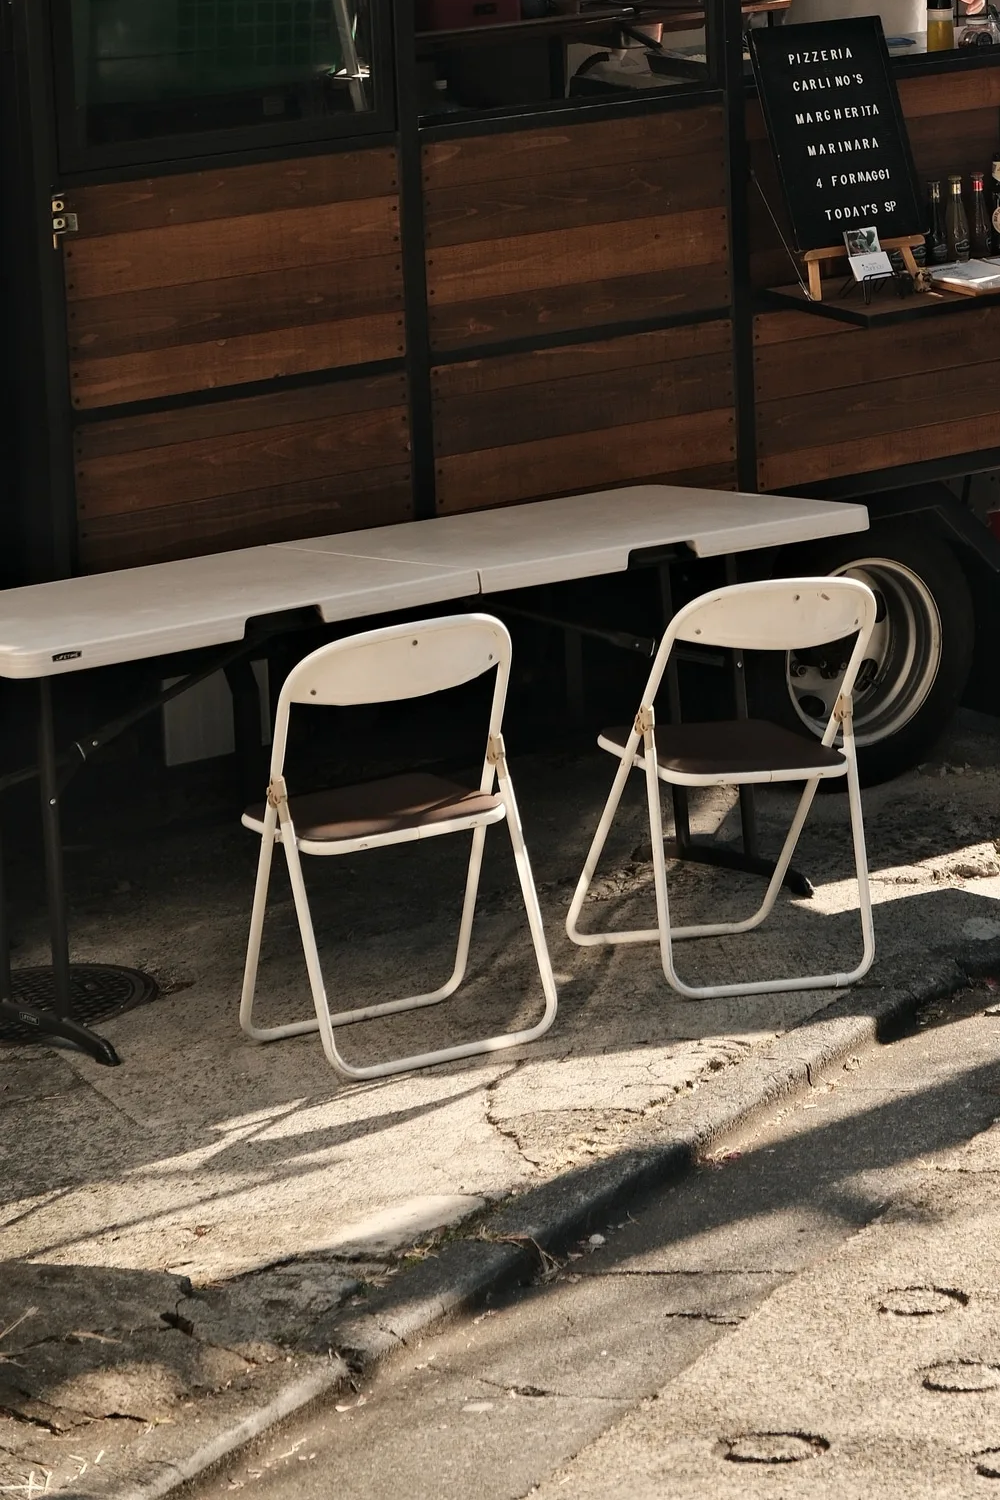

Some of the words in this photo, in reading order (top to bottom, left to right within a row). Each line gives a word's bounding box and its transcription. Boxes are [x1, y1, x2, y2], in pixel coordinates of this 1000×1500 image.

[788, 47, 853, 65] PIZZERIA
[795, 103, 880, 125] MARGHERITA
[807, 137, 880, 156] MARINARA
[816, 177, 824, 189] 4
[825, 203, 879, 221] TODAY'S
[884, 200, 897, 213] SP
